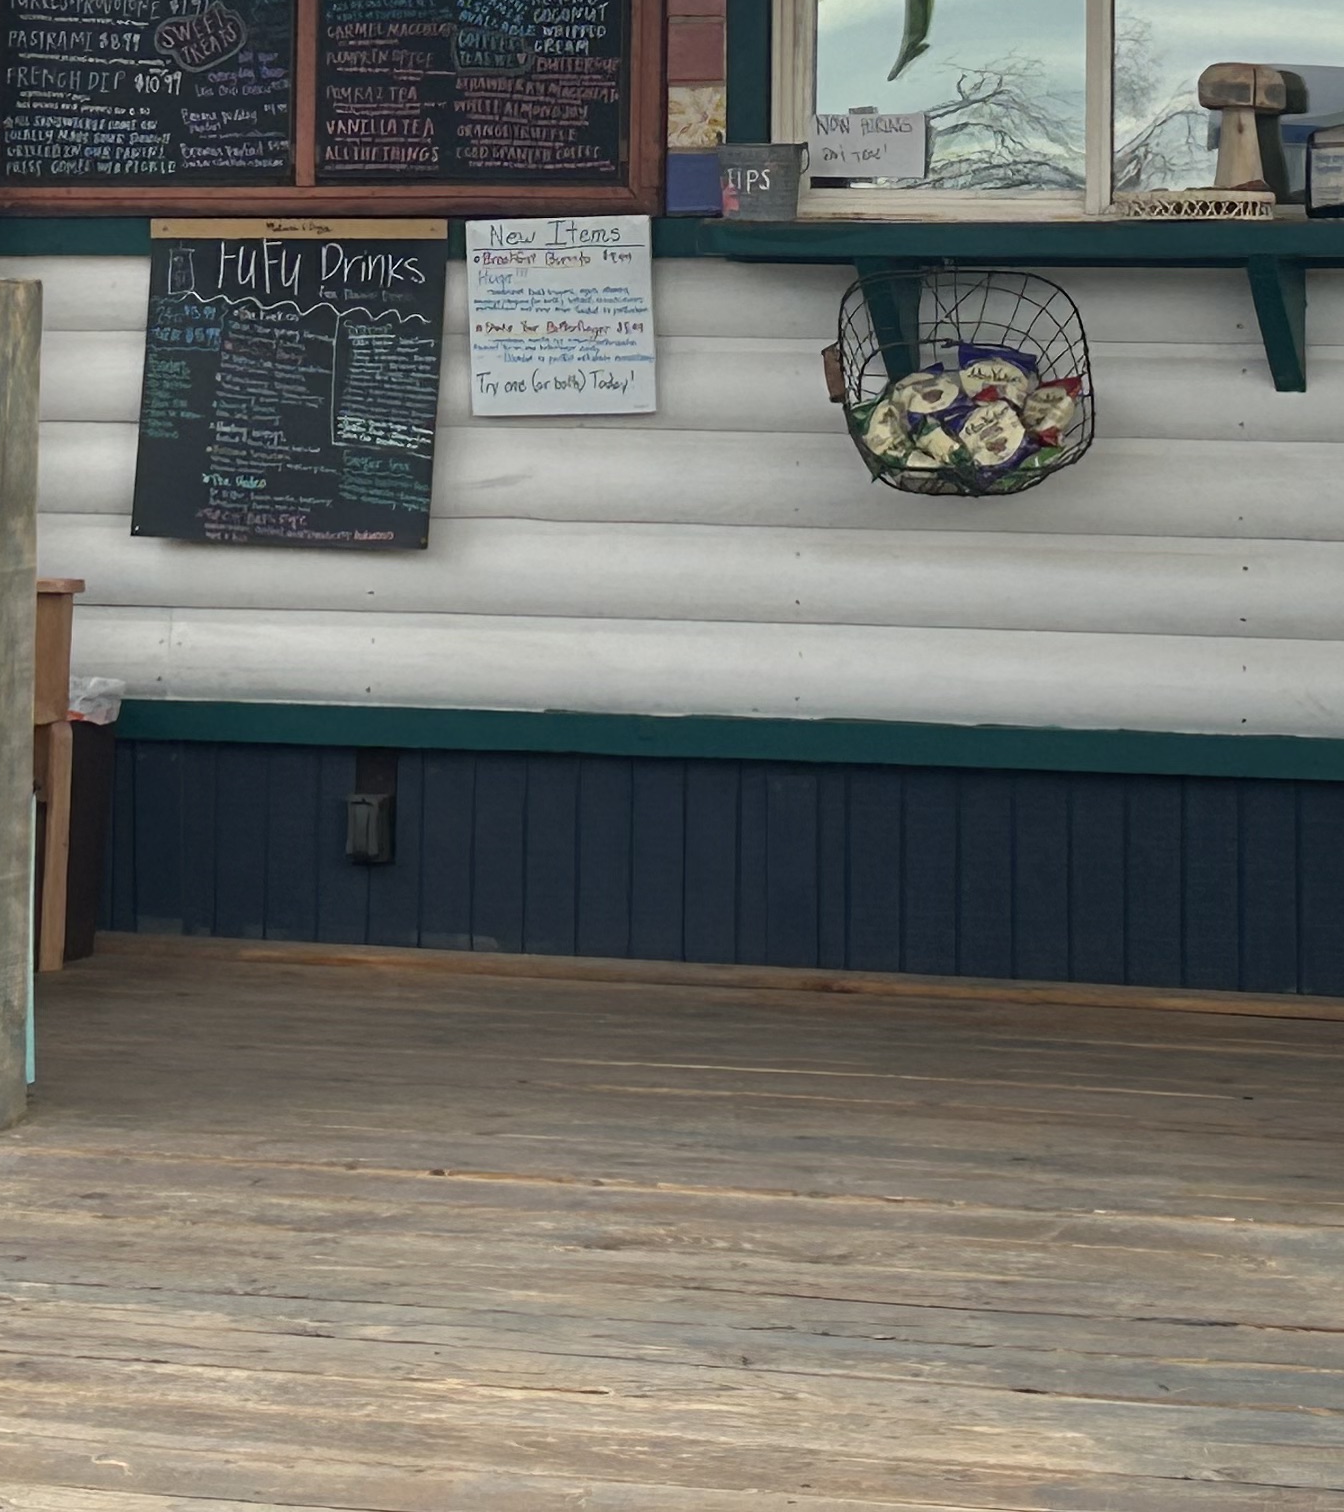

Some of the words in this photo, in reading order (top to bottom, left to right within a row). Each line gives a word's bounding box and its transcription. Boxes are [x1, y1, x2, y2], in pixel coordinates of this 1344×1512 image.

[8, 30, 94, 53] PASTRAMI
[6, 67, 83, 91] FRENCH
[88, 71, 126, 94] DIP
[325, 118, 397, 136] VANILLA
[400, 117, 435, 137] TEA
[815, 115, 850, 136] NOW
[726, 168, 771, 194] TIPS
[490, 224, 537, 247] New
[545, 220, 621, 246] Items
[320, 242, 426, 290] Drinks
[476, 371, 499, 396] Try
